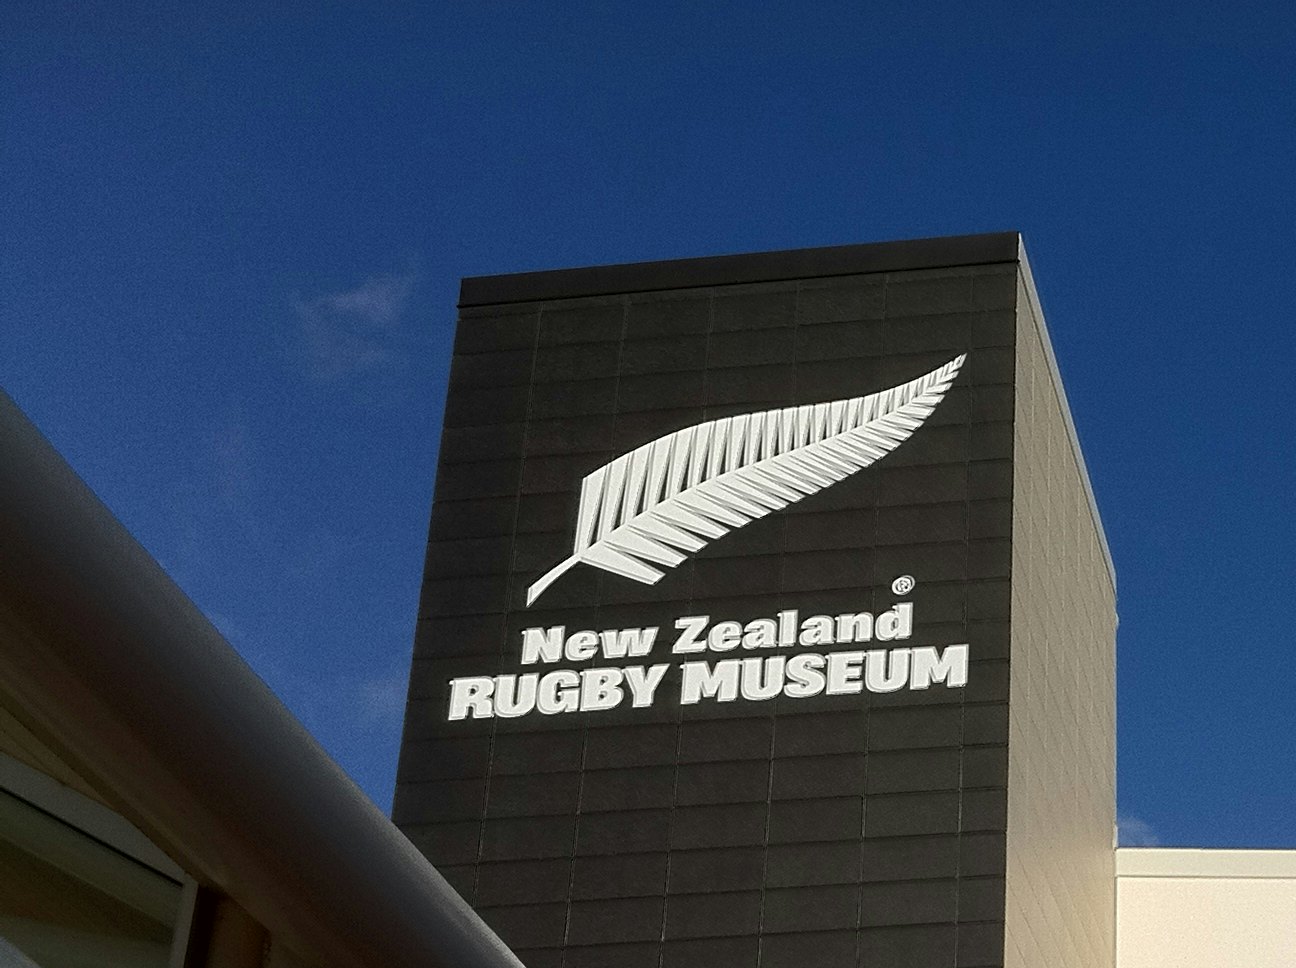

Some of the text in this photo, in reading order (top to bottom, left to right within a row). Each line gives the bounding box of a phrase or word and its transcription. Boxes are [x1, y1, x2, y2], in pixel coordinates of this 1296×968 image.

[520, 602, 914, 665] New Zealand
[447, 644, 969, 721] RUGBY MUSEUM
